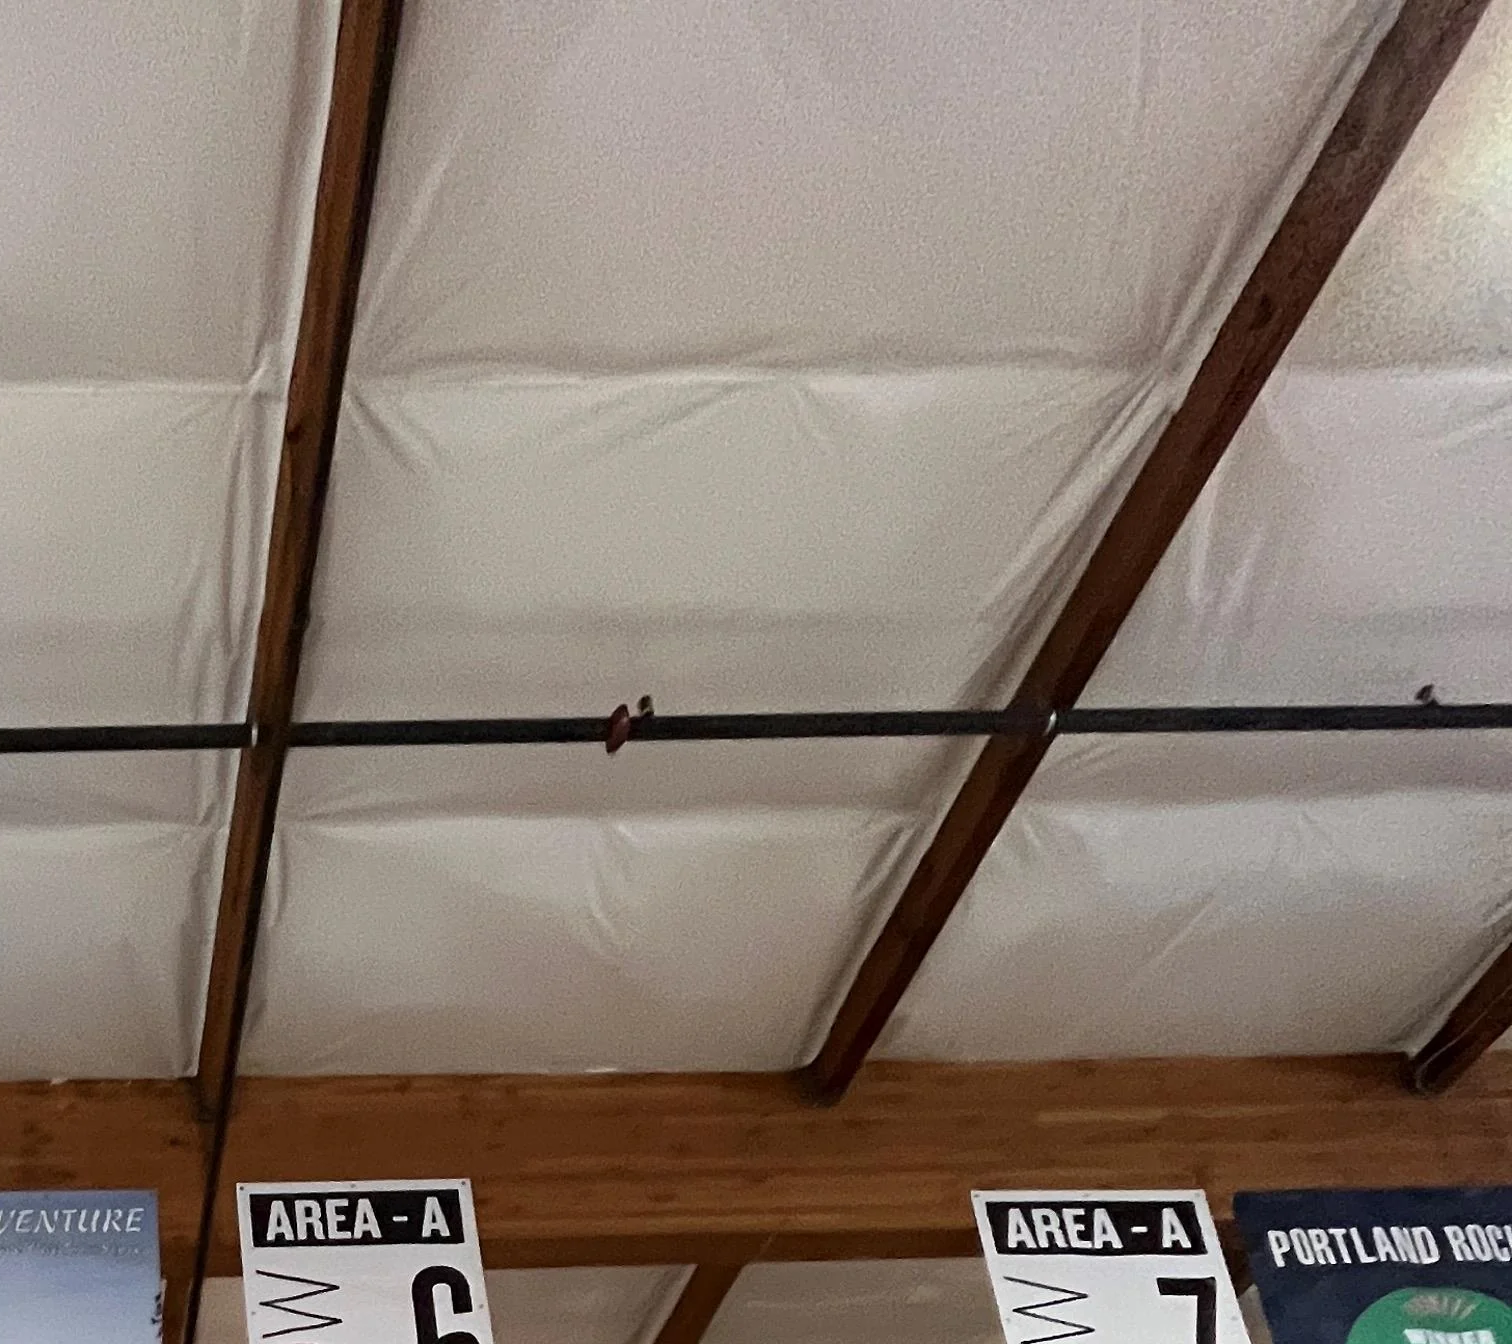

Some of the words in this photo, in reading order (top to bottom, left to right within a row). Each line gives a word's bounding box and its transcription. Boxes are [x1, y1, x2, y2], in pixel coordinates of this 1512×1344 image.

[266, 1198, 382, 1241] AREA
[1006, 1207, 1123, 1250] AREA
[1267, 1226, 1441, 1268] PORTLAND
